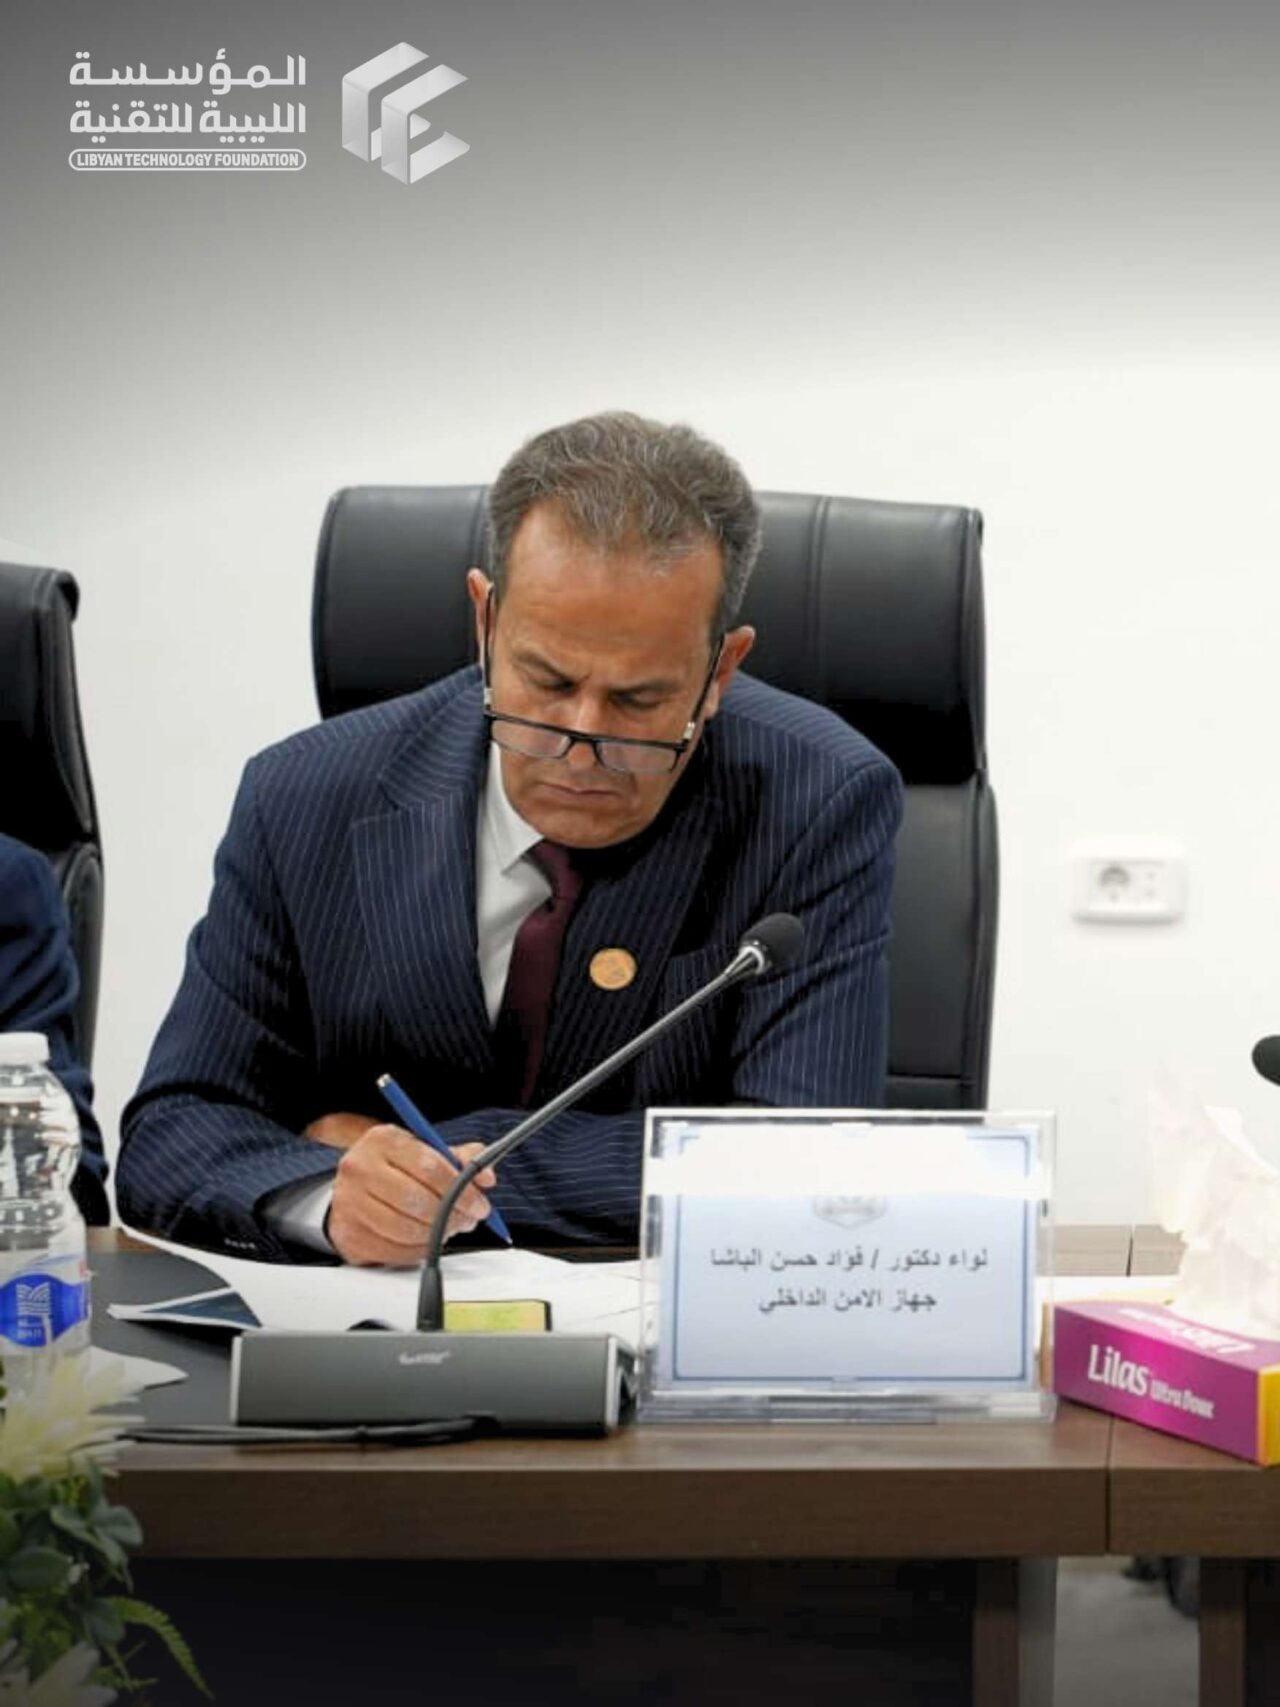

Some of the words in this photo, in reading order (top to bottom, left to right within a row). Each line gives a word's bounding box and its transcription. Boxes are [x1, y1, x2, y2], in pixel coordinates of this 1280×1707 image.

[710, 1247, 762, 1272] الباشا
[769, 1251, 818, 1272] حسن
[887, 1249, 941, 1272] دكتور
[947, 1248, 988, 1272] لواء
[758, 1287, 827, 1314] الداخلي
[891, 1287, 937, 1313] جهاز
[1088, 1343, 1151, 1397] Lilas
